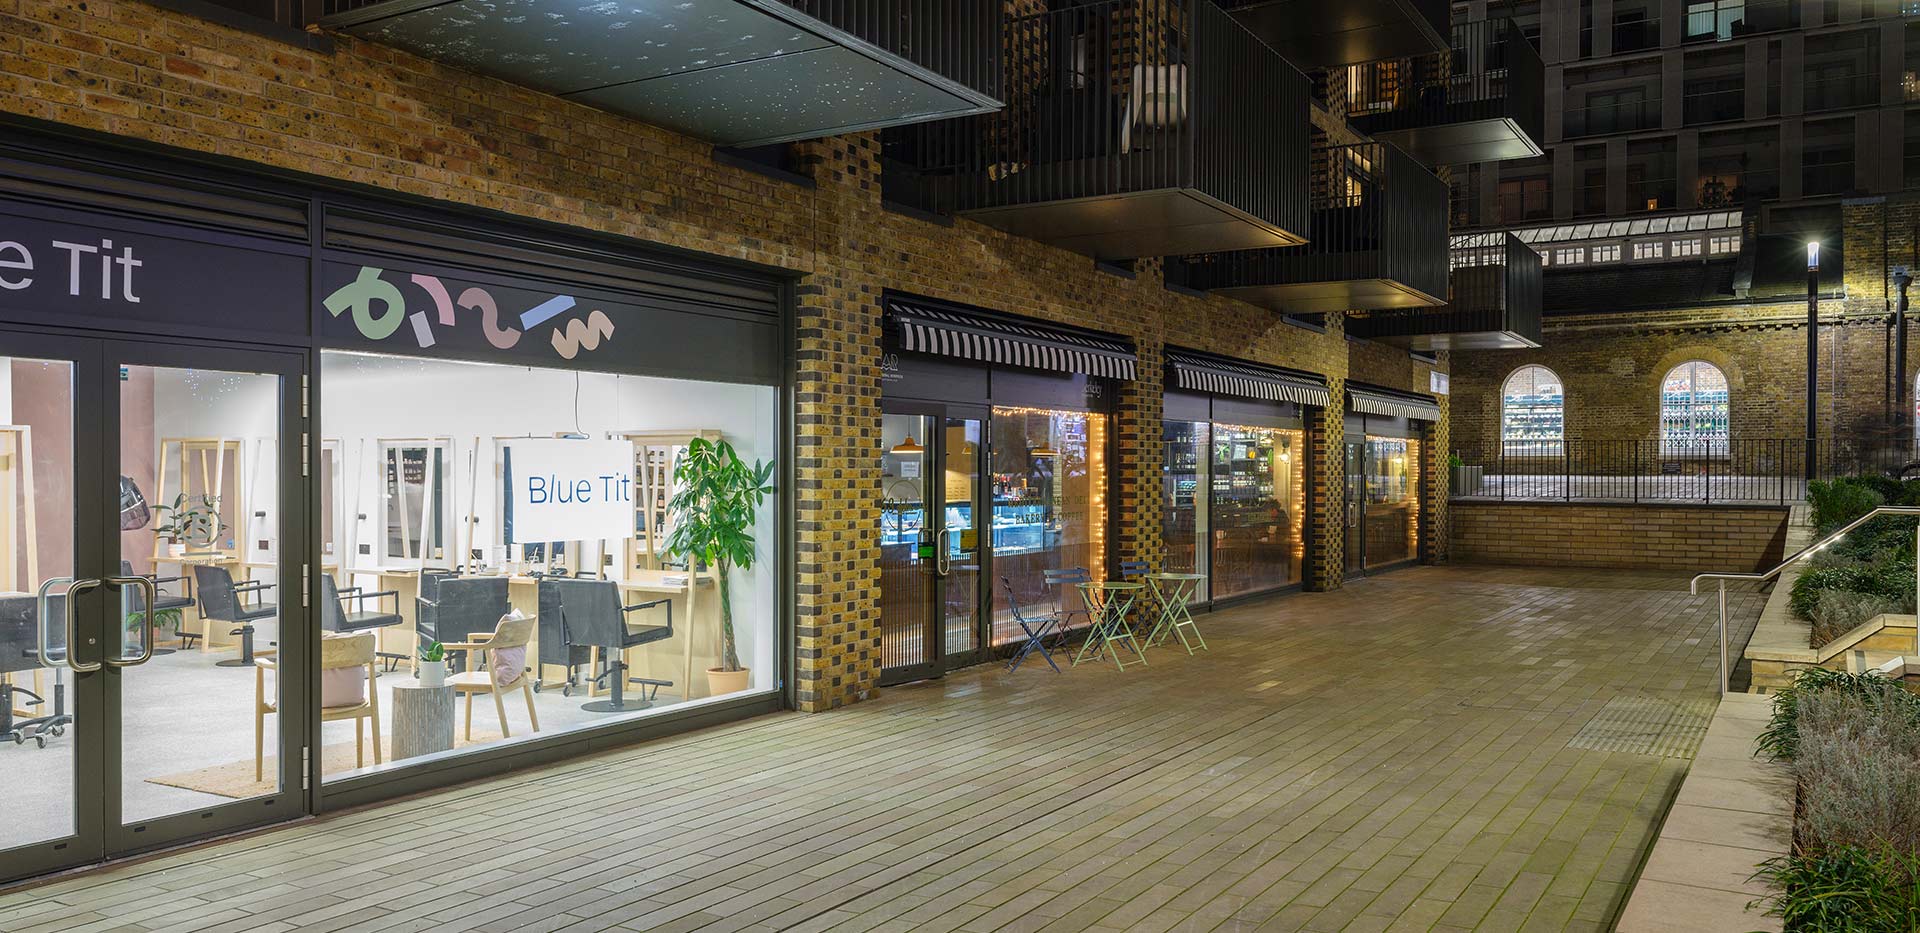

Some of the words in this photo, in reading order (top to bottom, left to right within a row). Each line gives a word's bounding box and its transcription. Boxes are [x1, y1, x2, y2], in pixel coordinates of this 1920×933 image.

[52, 238, 143, 303] Tit
[528, 474, 592, 504] Blue
[599, 472, 631, 502] Tit
[1058, 511, 1083, 521] COFFEE
[180, 558, 224, 566] Corporation
